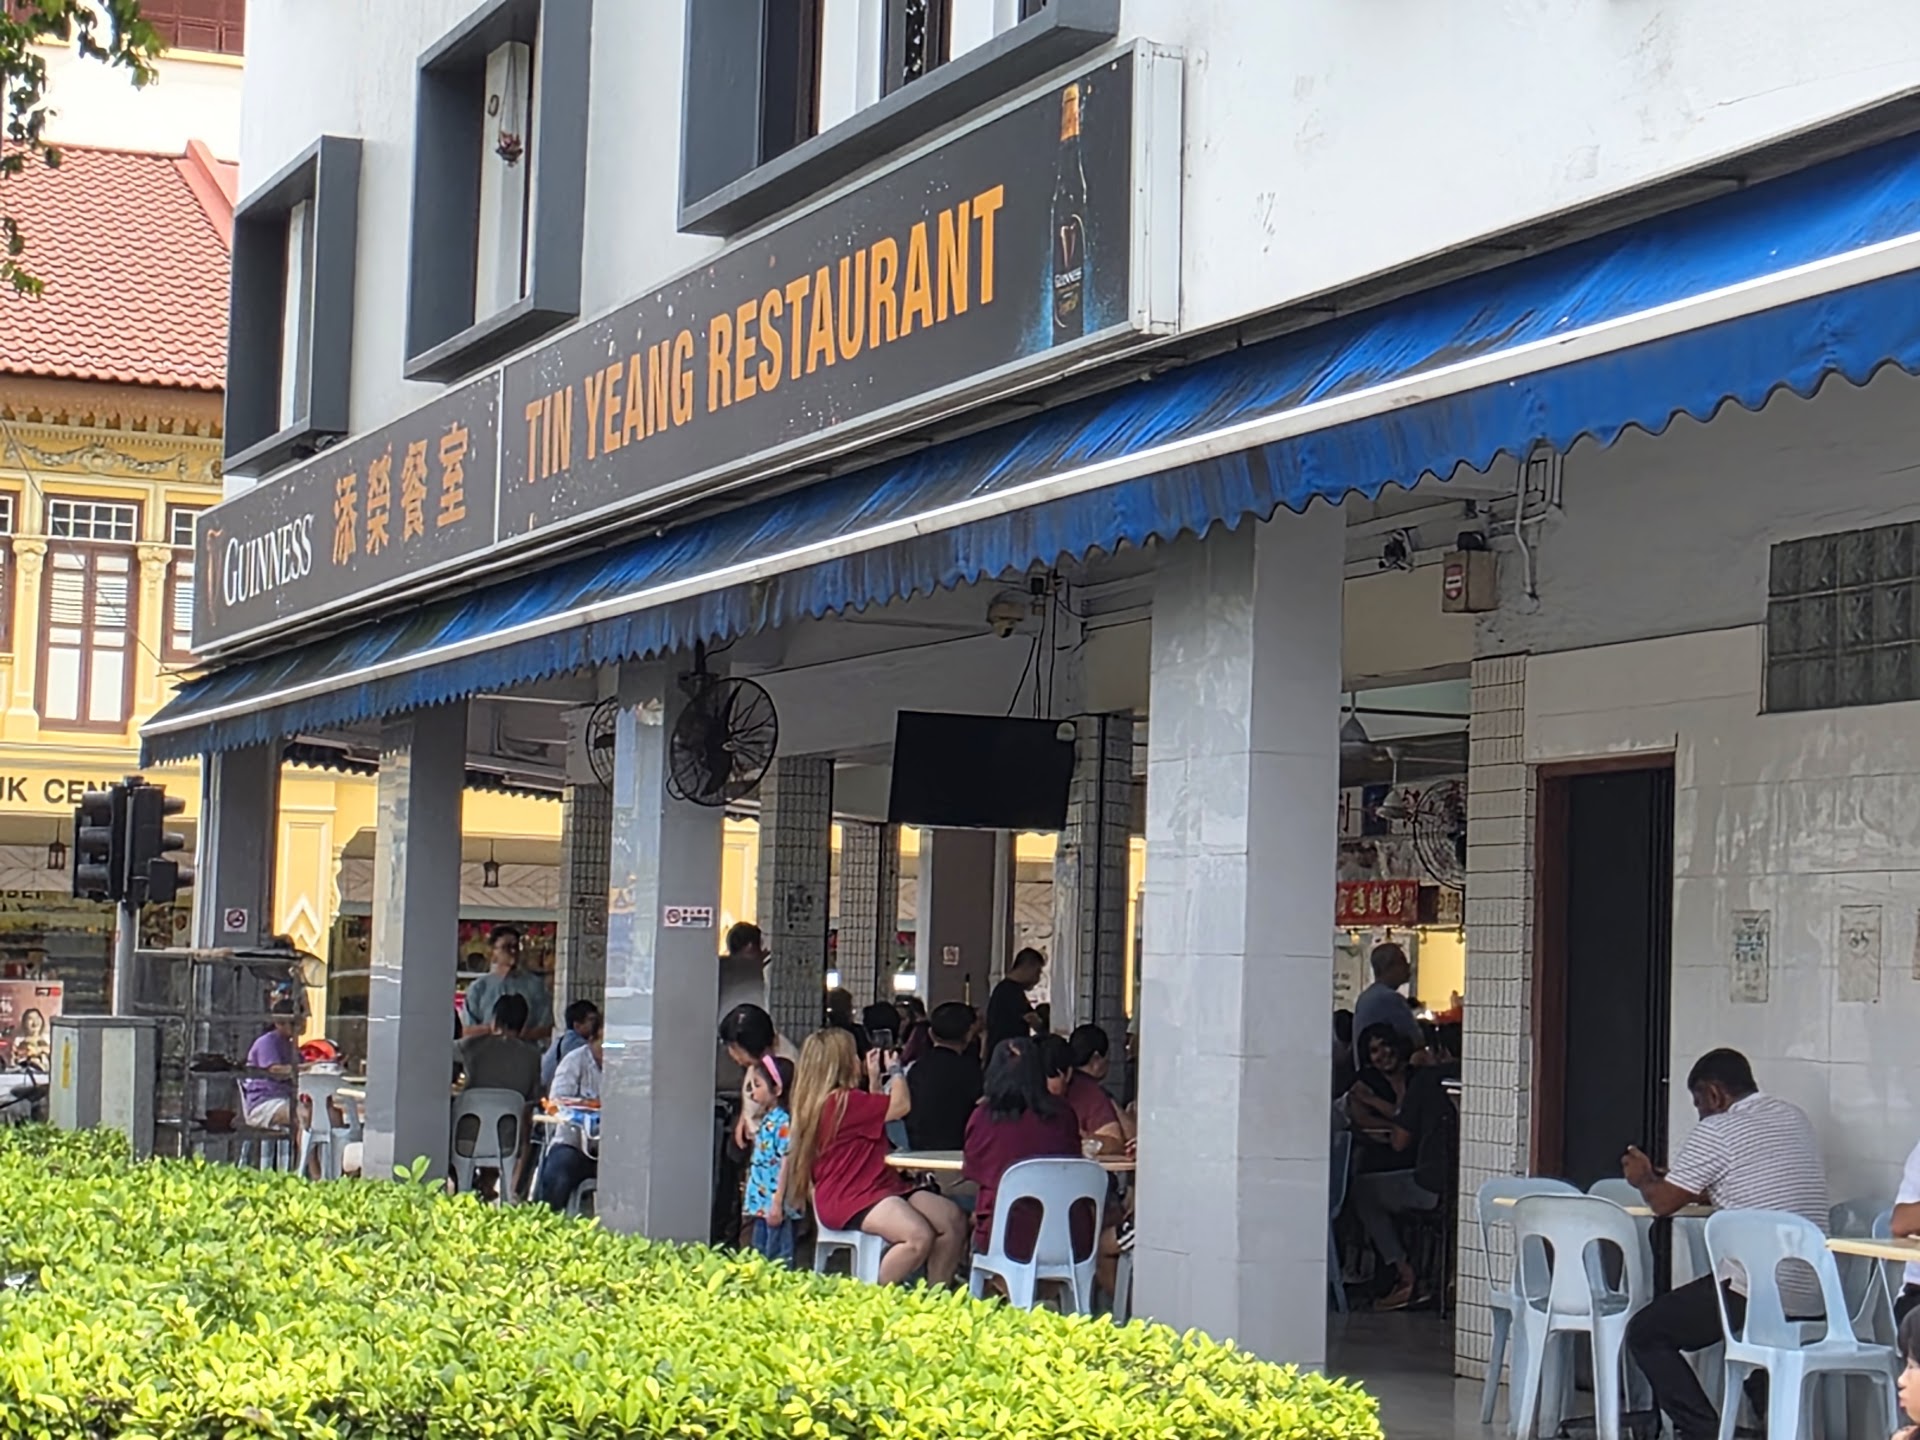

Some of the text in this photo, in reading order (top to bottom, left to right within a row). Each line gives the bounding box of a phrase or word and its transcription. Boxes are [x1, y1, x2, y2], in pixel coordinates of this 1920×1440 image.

[525, 184, 1004, 483] TIN YEANG RESTAURANT
[223, 513, 315, 606] GUINNESS
